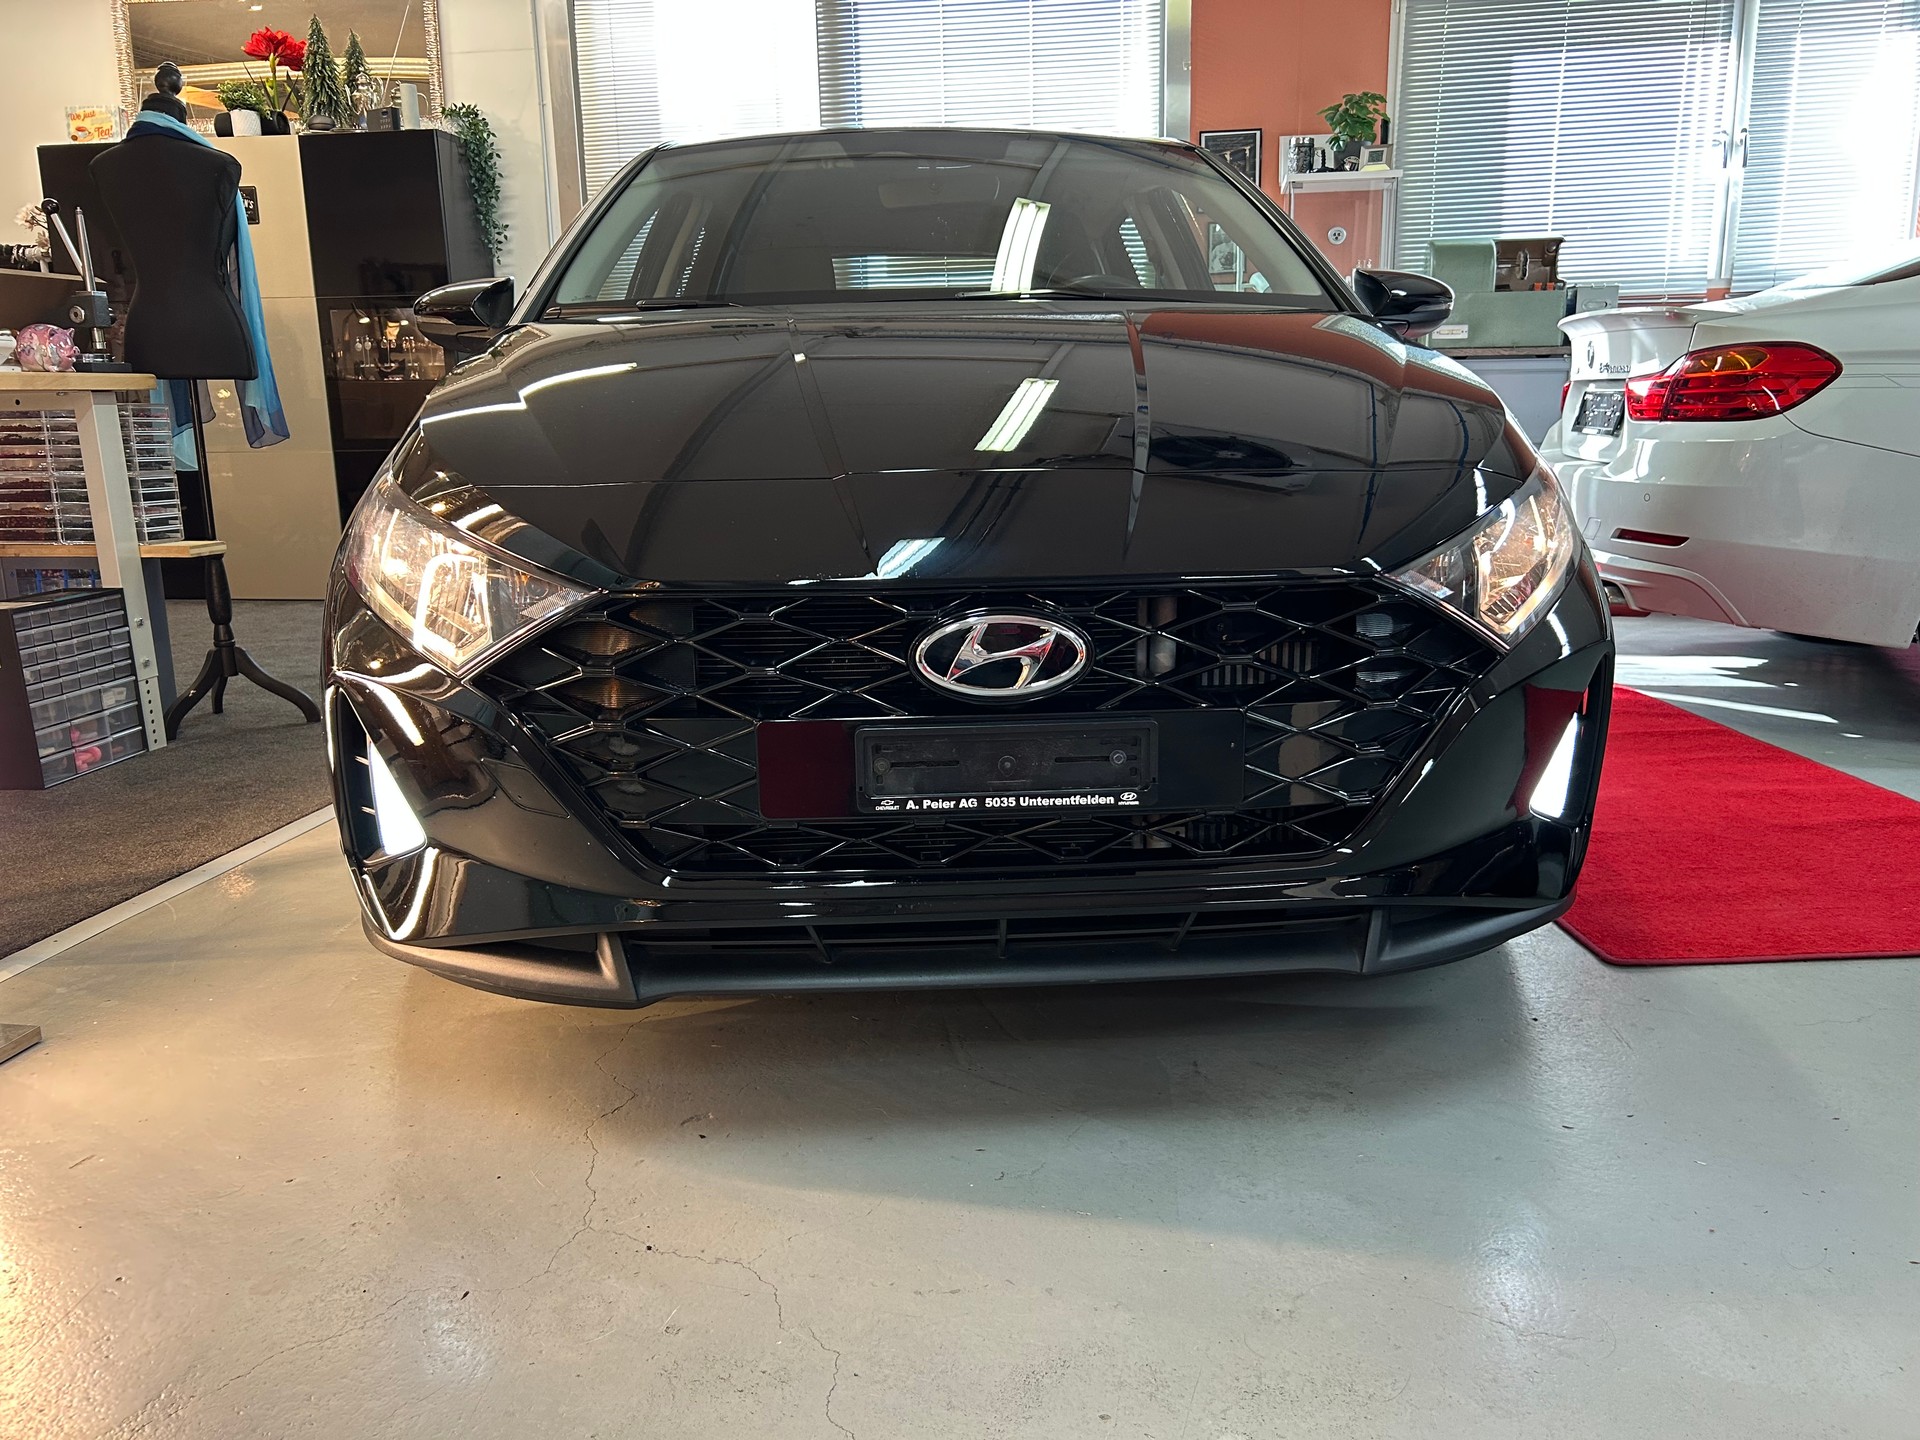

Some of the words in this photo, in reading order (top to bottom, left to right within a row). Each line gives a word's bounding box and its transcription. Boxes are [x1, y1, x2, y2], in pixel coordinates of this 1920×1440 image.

[906, 799, 919, 810] A.
[922, 798, 956, 809] Peier
[958, 798, 978, 808] AG
[984, 797, 1016, 808] 5035
[1019, 795, 1115, 807] Unterentfelden
